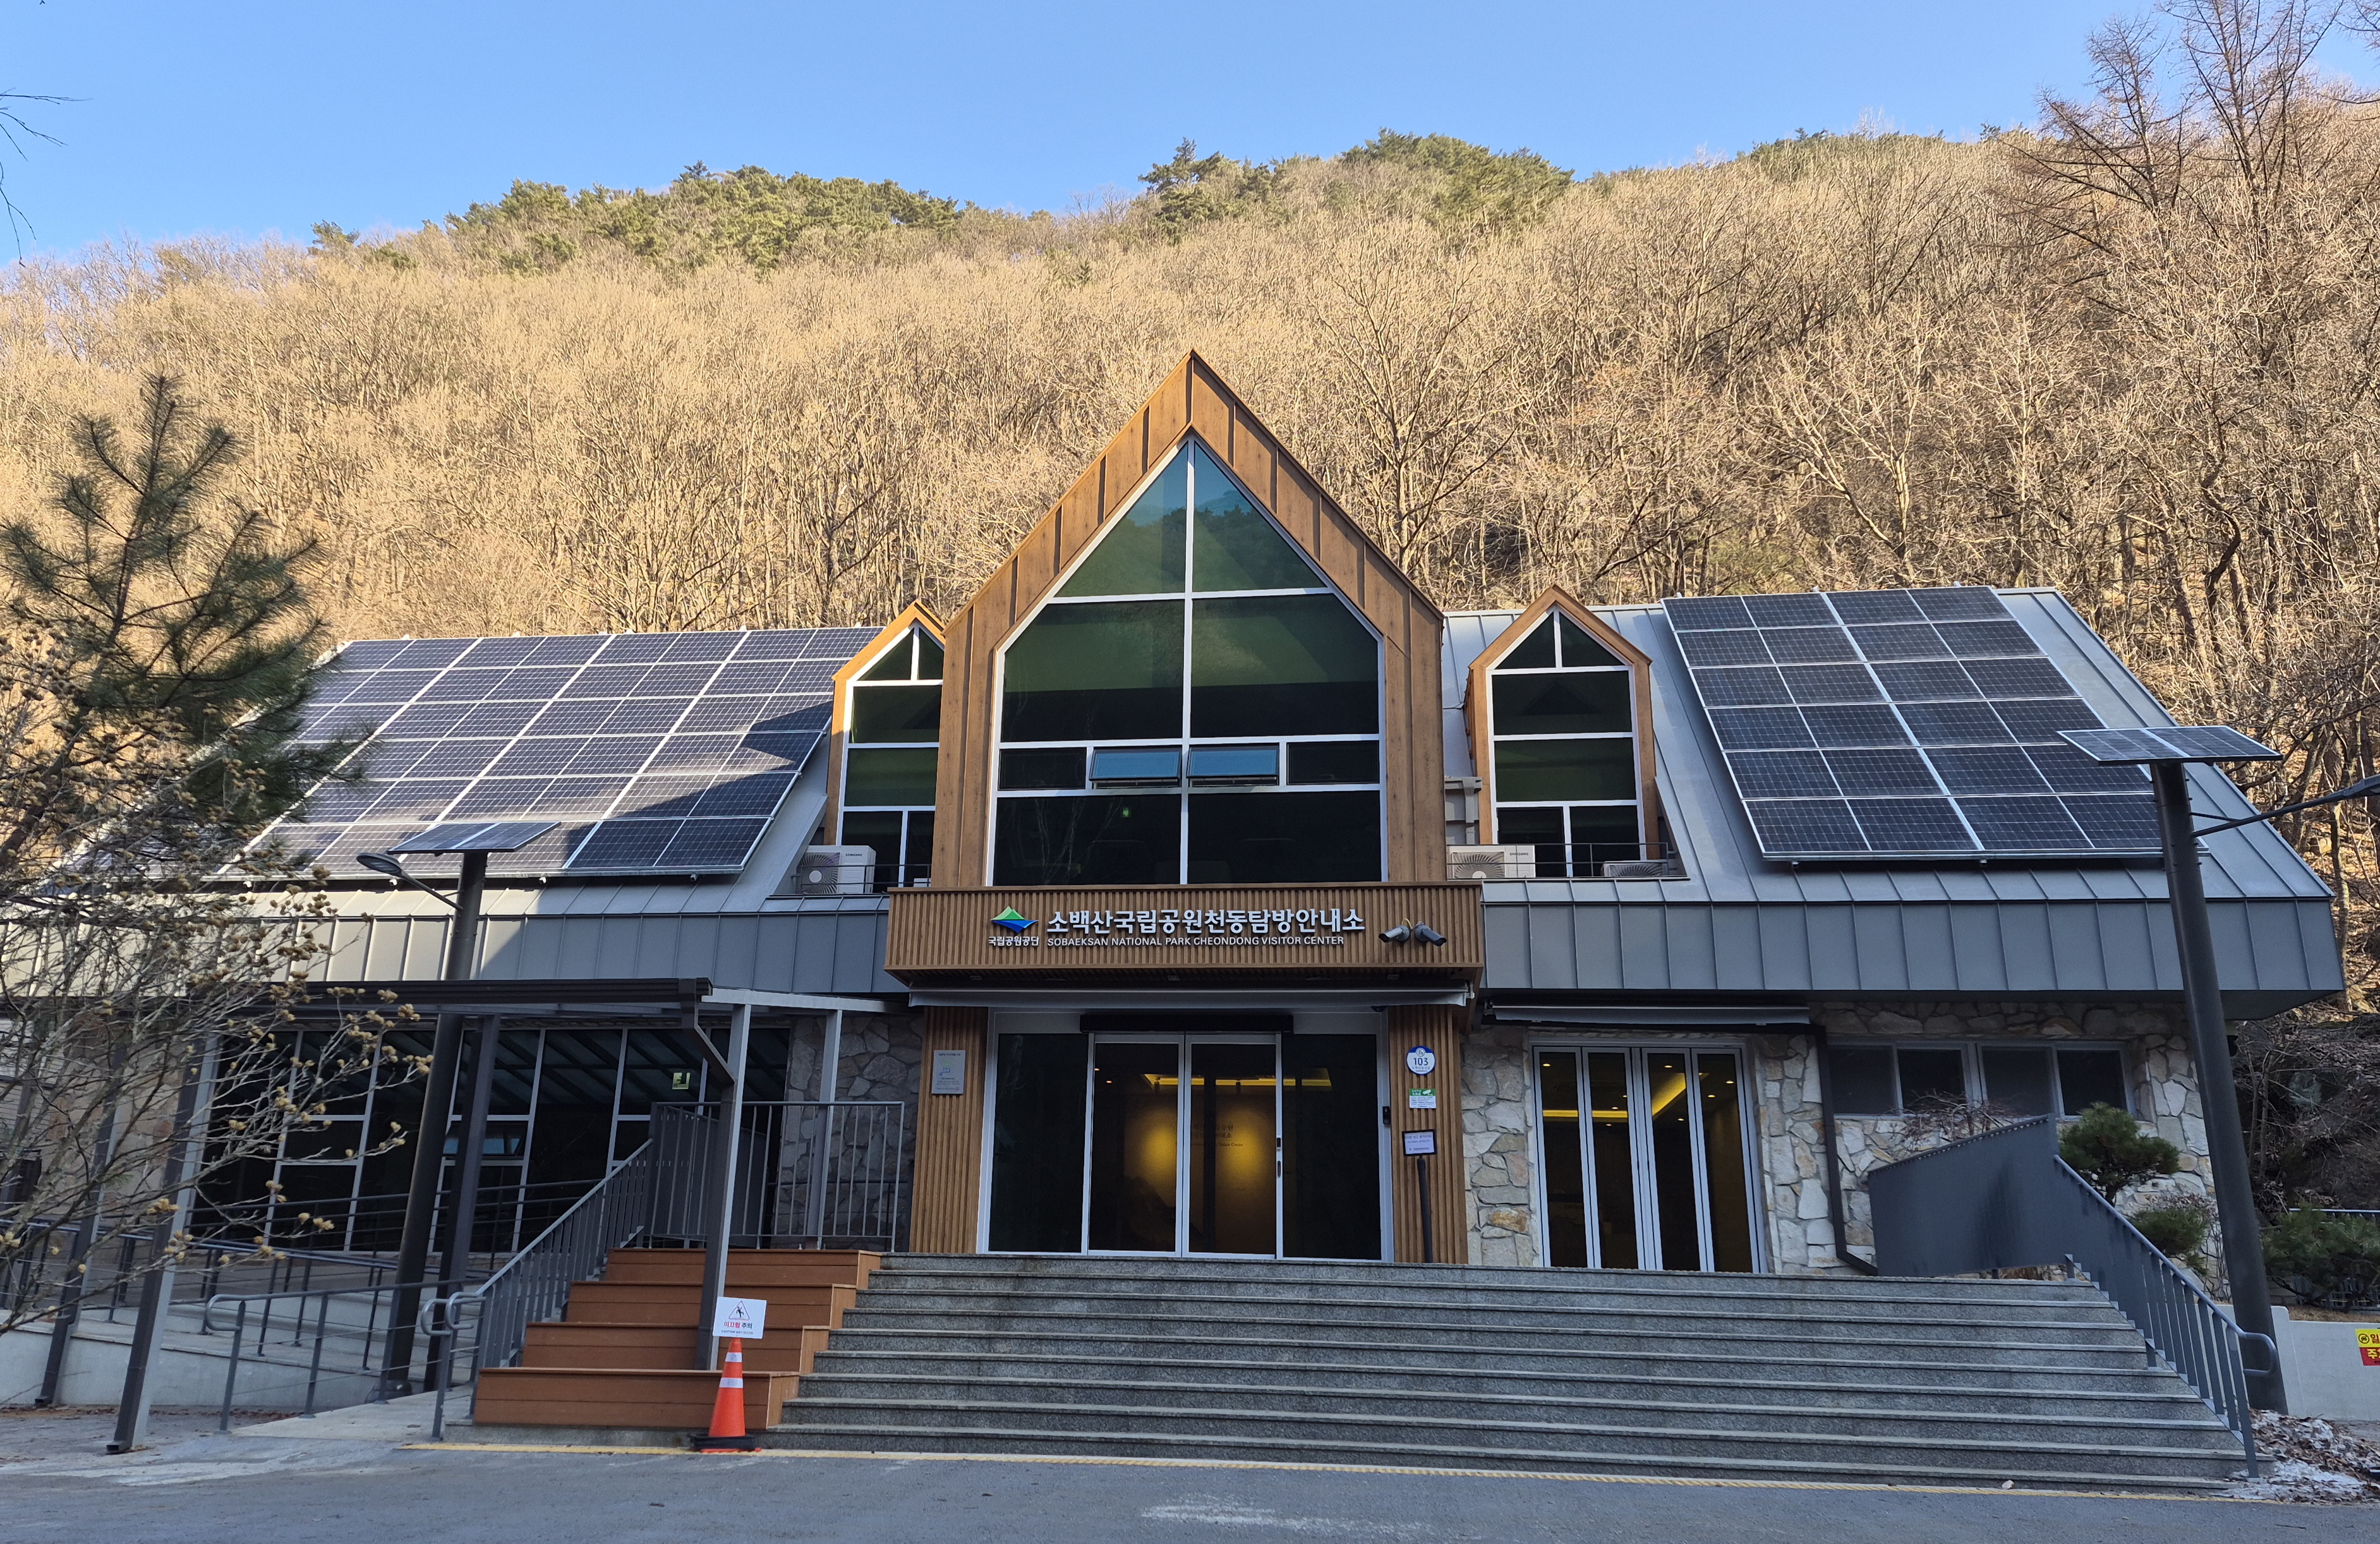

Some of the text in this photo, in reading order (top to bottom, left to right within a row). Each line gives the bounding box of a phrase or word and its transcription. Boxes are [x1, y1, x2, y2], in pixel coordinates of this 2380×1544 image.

[1046, 908, 1365, 934] 소백산국립공원천동탐방안내소
[988, 936, 1039, 946] 국립공원공단
[1047, 936, 1344, 946] SOBAEKSAN NATIONAL PARK CHEONDONG VISITOR CENTER
[1413, 1058, 1429, 1066] 103
